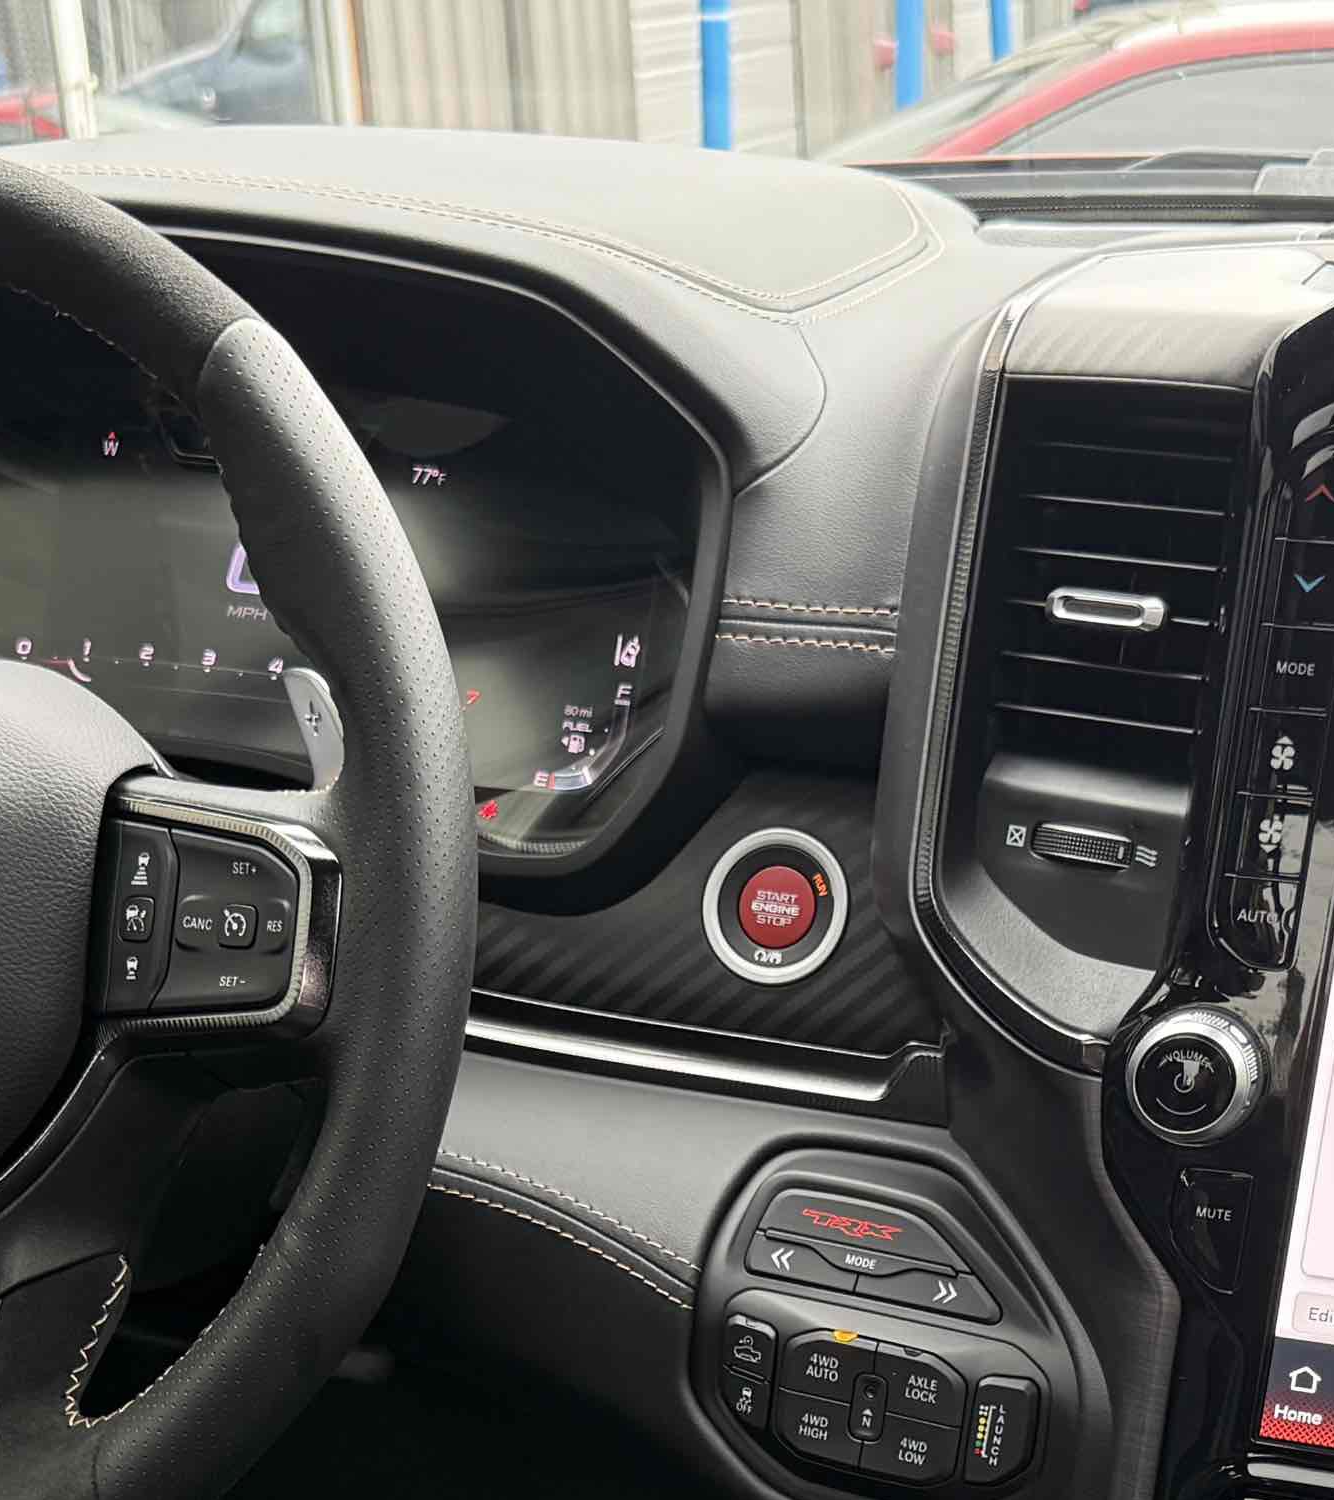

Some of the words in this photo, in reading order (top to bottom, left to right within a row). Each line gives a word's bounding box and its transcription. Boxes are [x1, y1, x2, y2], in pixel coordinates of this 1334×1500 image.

[103, 439, 119, 456] W
[226, 604, 267, 622] MPH
[17, 637, 33, 656] 0
[83, 637, 93, 656] 1
[139, 643, 155, 661] 2
[202, 648, 217, 667] 3
[268, 656, 284, 674] 4
[1275, 660, 1316, 677] MODE
[755, 889, 799, 906] START
[751, 900, 802, 917] ENGINE
[1235, 907, 1281, 926] AUTO
[182, 915, 213, 932] CANC
[266, 918, 283, 933] RES
[756, 914, 793, 928] STOP
[1163, 1049, 1212, 1068] VOLUME
[1195, 1204, 1233, 1223] MUTE
[801, 1207, 905, 1241] TRX
[843, 1253, 877, 1271] MODE
[808, 1352, 840, 1370] 4WD
[805, 1365, 840, 1383] AUTO
[906, 1374, 939, 1393] AXLE
[903, 1386, 937, 1406] LOCK
[735, 1400, 754, 1416] OFF
[1273, 1403, 1324, 1426] Home
[801, 1411, 830, 1428] 4WD
[862, 1414, 872, 1428] N
[797, 1423, 829, 1442] HIGH
[987, 1403, 1006, 1468] LAUNCH
[898, 1436, 928, 1454] 4WD
[897, 1447, 927, 1466] LOW
